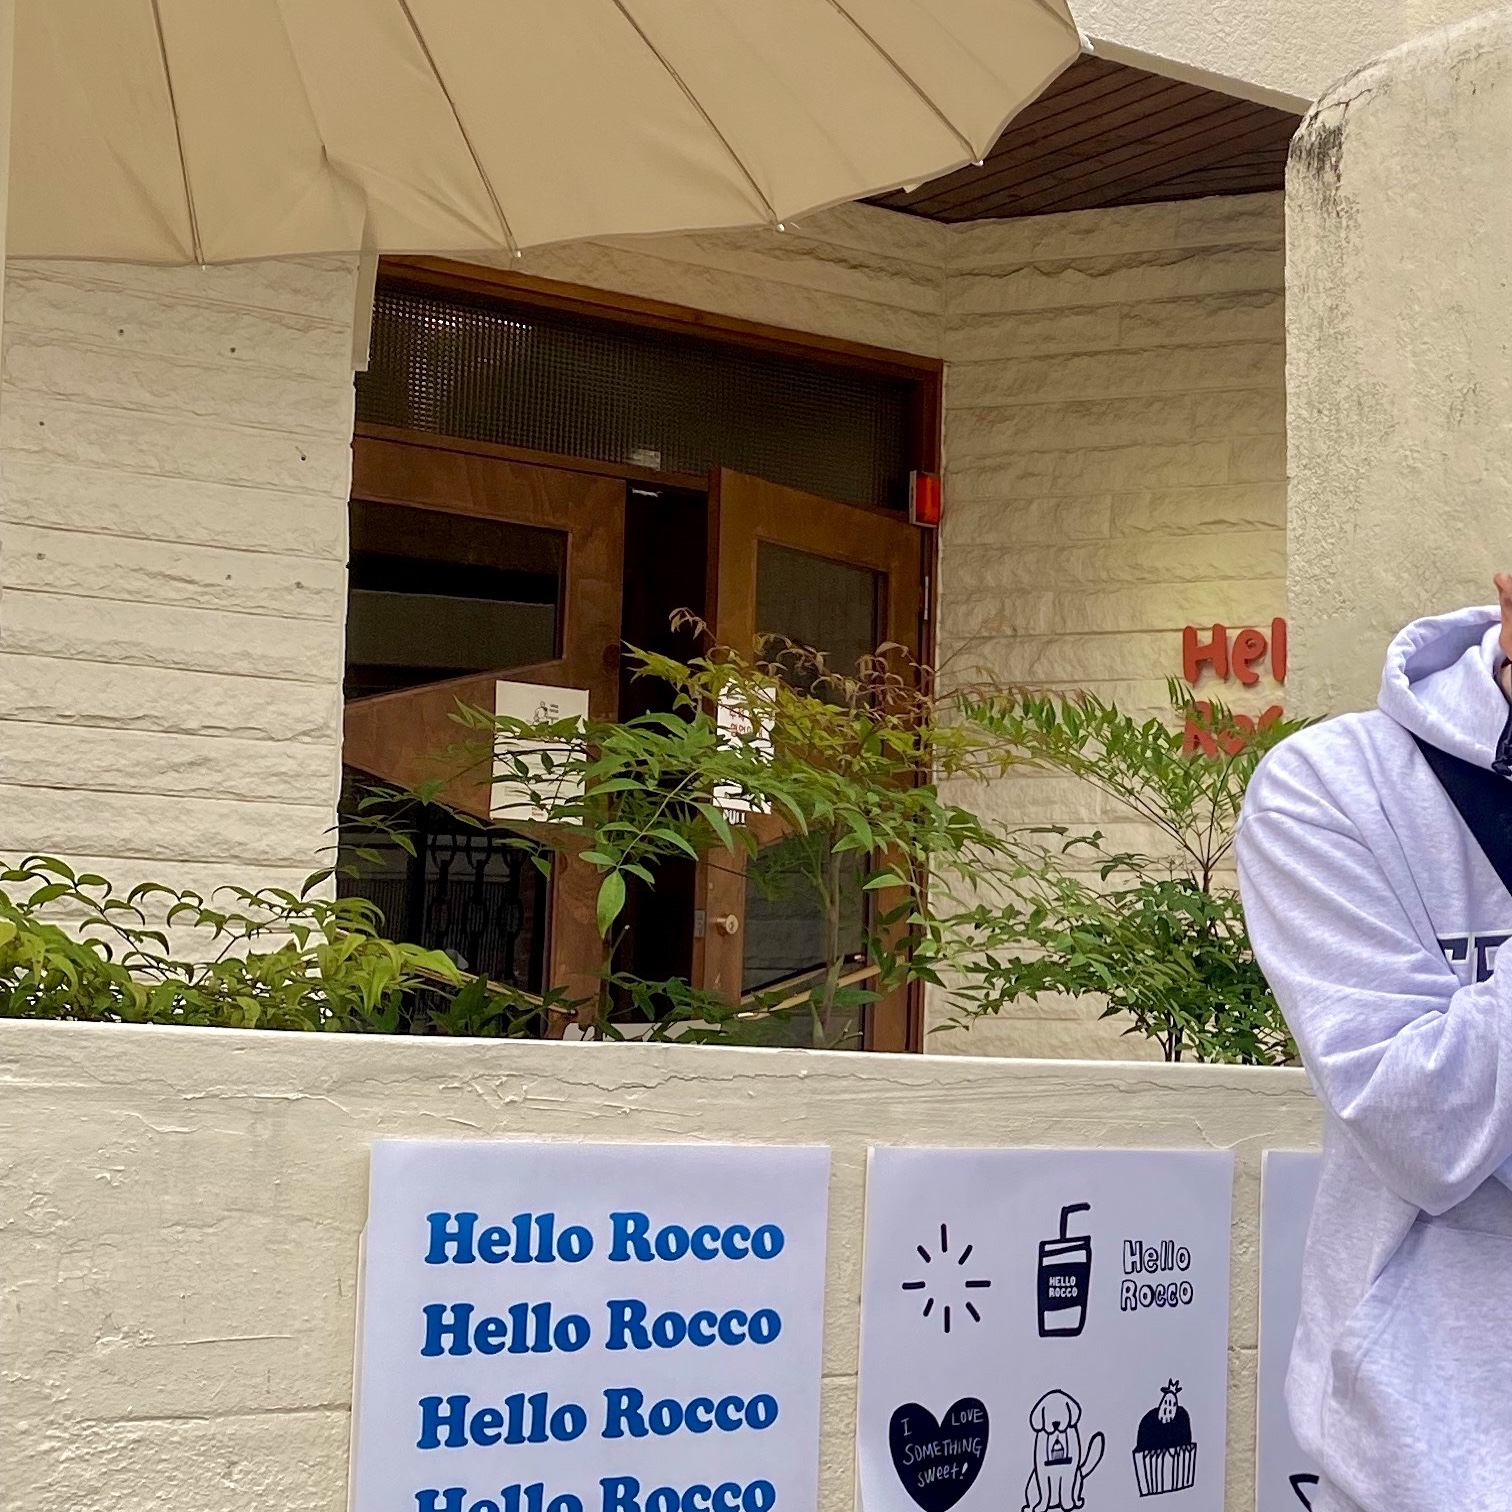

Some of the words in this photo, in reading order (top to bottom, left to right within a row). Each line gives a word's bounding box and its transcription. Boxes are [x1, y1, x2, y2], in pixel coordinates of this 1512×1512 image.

[424, 1210, 595, 1265] Hello
[608, 1209, 785, 1264] Rocco
[1122, 1239, 1192, 1275] Hello
[1049, 1275, 1076, 1287] HELLO
[1049, 1287, 1078, 1298] ROCCO
[1120, 1278, 1194, 1312] Rocco
[421, 1301, 592, 1358] Hello
[605, 1297, 783, 1352] Rocco
[416, 1391, 588, 1450] Hello
[602, 1385, 780, 1439] Rocco
[900, 1417, 913, 1437] I
[951, 1408, 984, 1426] LOVE
[902, 1437, 983, 1466] SOMETHING
